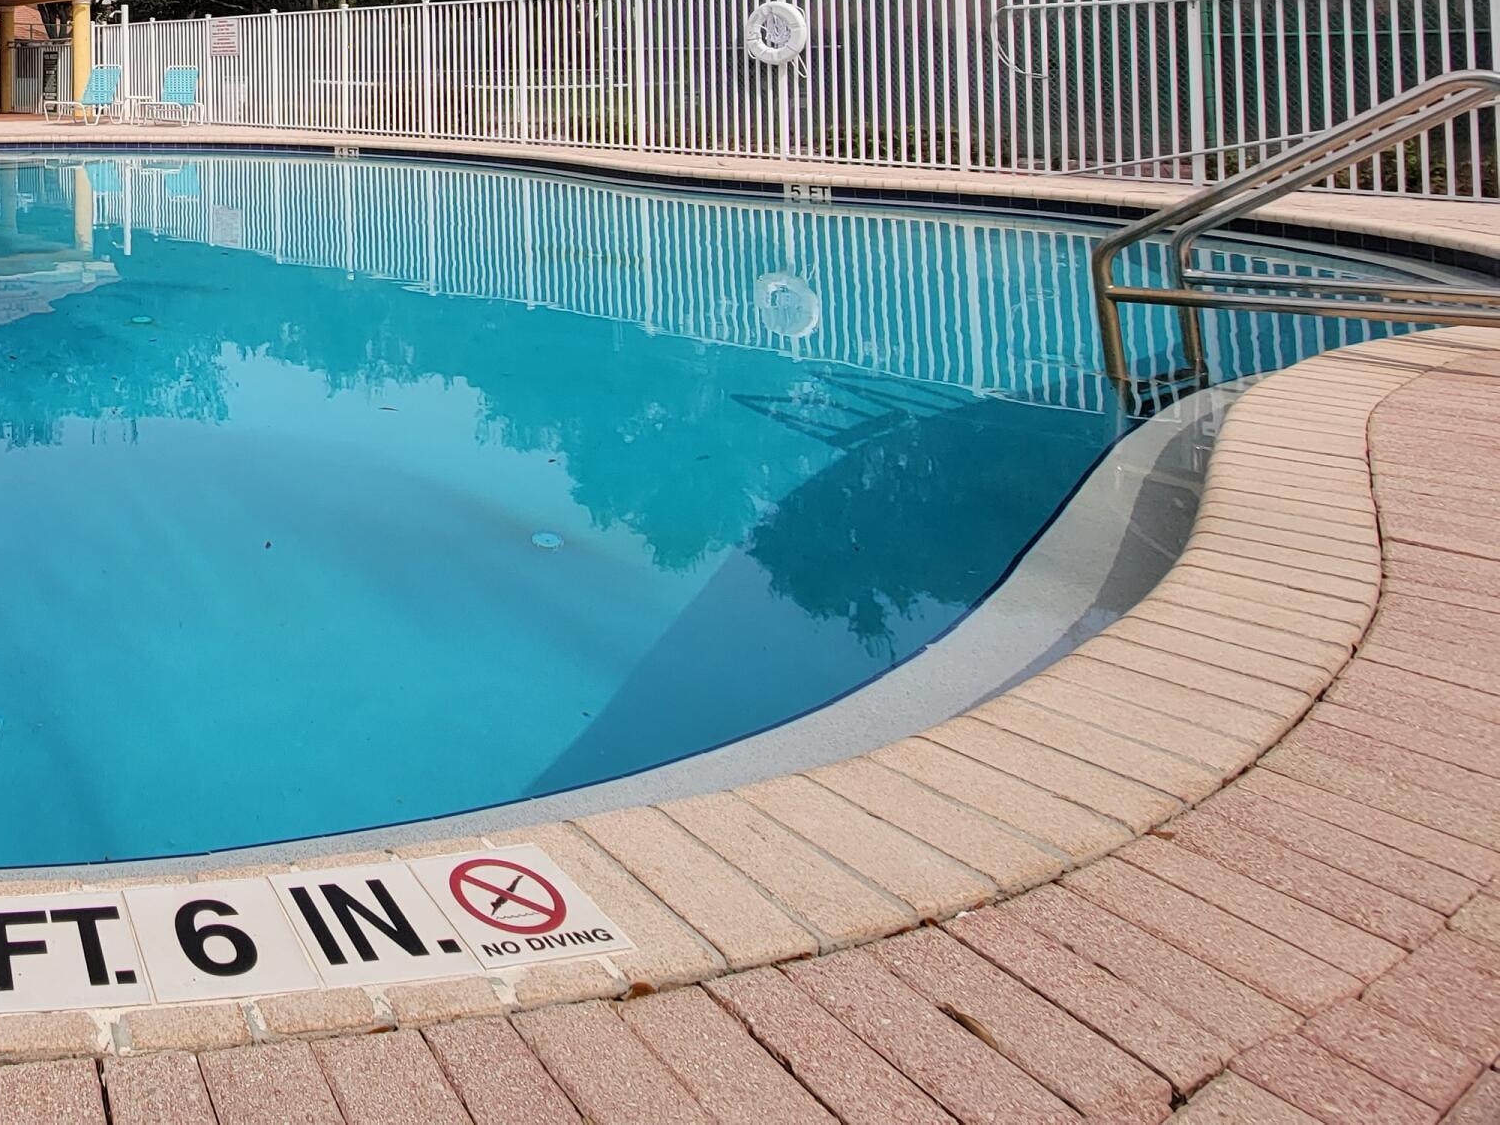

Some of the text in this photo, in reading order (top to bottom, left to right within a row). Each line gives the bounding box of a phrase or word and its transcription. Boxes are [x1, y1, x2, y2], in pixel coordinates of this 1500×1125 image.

[791, 184, 829, 201] 5 FT
[175, 899, 258, 976] 6
[288, 878, 462, 965] IN.
[481, 928, 615, 957] NO DIVING
